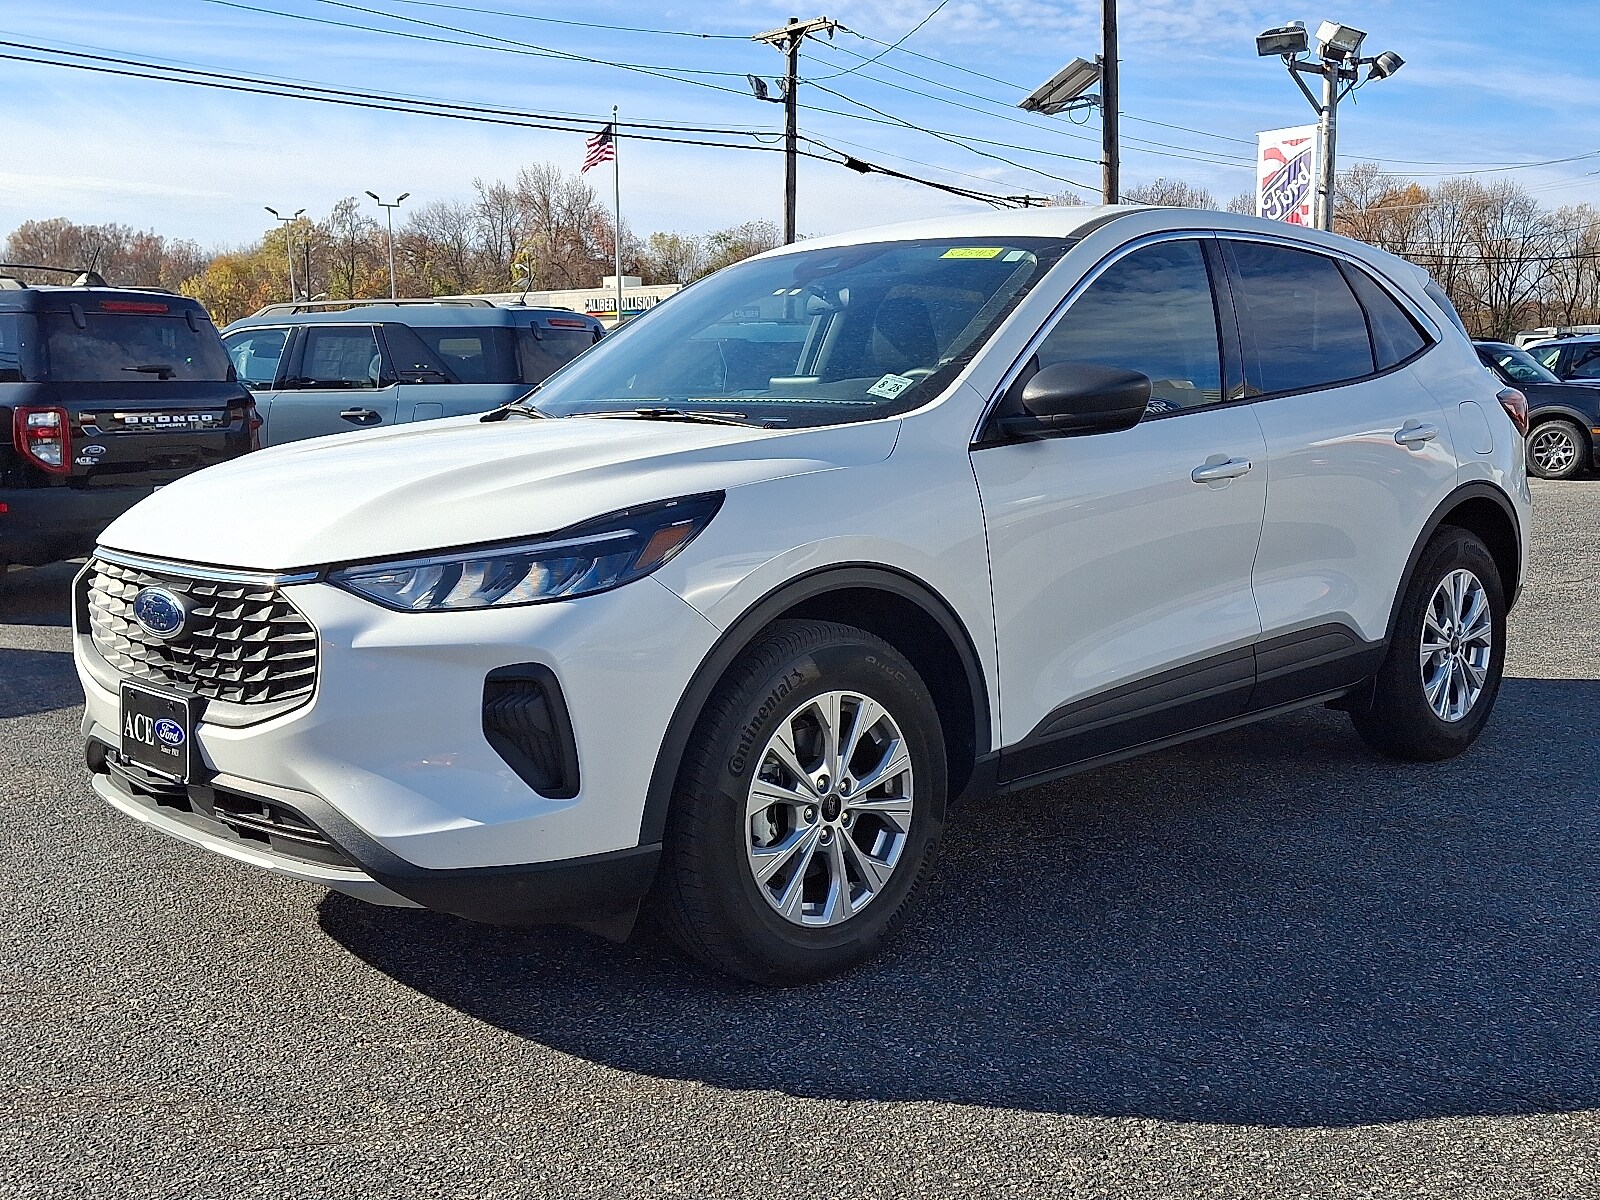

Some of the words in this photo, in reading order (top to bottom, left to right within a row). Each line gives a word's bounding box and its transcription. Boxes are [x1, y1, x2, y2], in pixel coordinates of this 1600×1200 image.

[1262, 161, 1310, 220] Ford
[584, 299, 616, 312] CALIBER
[888, 383, 902, 393] 28
[124, 414, 212, 424] BRONCO
[123, 710, 155, 746] ACE
[159, 722, 180, 743] Ford
[728, 675, 797, 777] Continental
